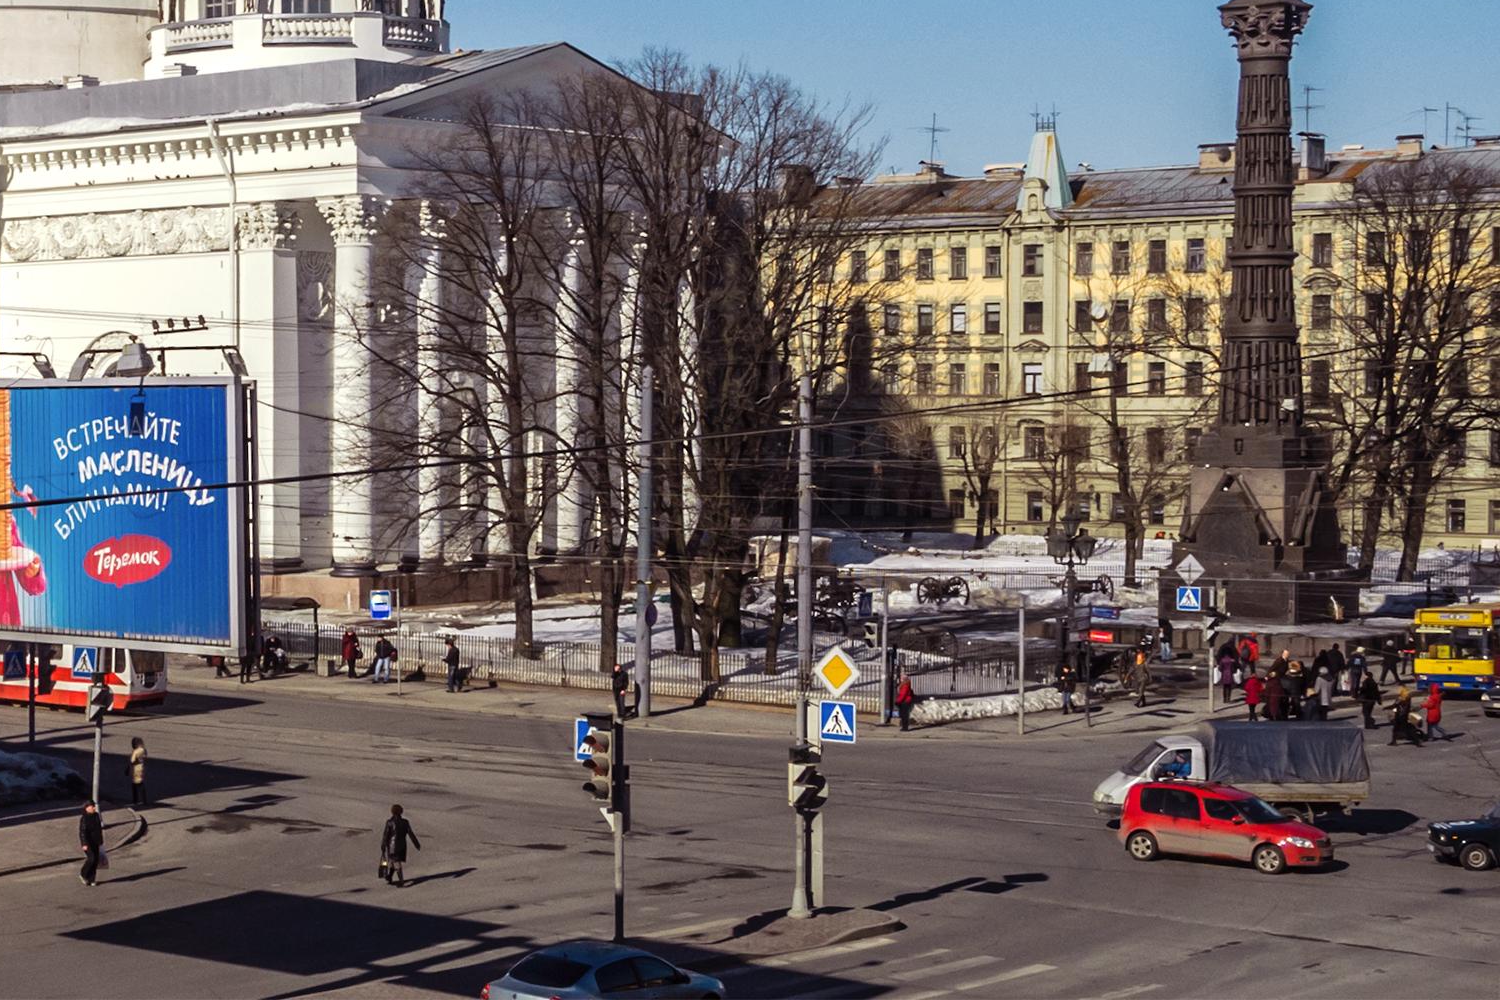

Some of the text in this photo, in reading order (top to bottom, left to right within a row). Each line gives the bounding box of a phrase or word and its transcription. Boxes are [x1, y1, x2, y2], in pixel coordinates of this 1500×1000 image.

[53, 412, 181, 461] ВСТРЕЧАЙТЕ
[78, 449, 215, 507] МАСЛЕНИЦУ
[54, 482, 168, 541] БЛИНАМИ!
[94, 547, 160, 576] Теремок
